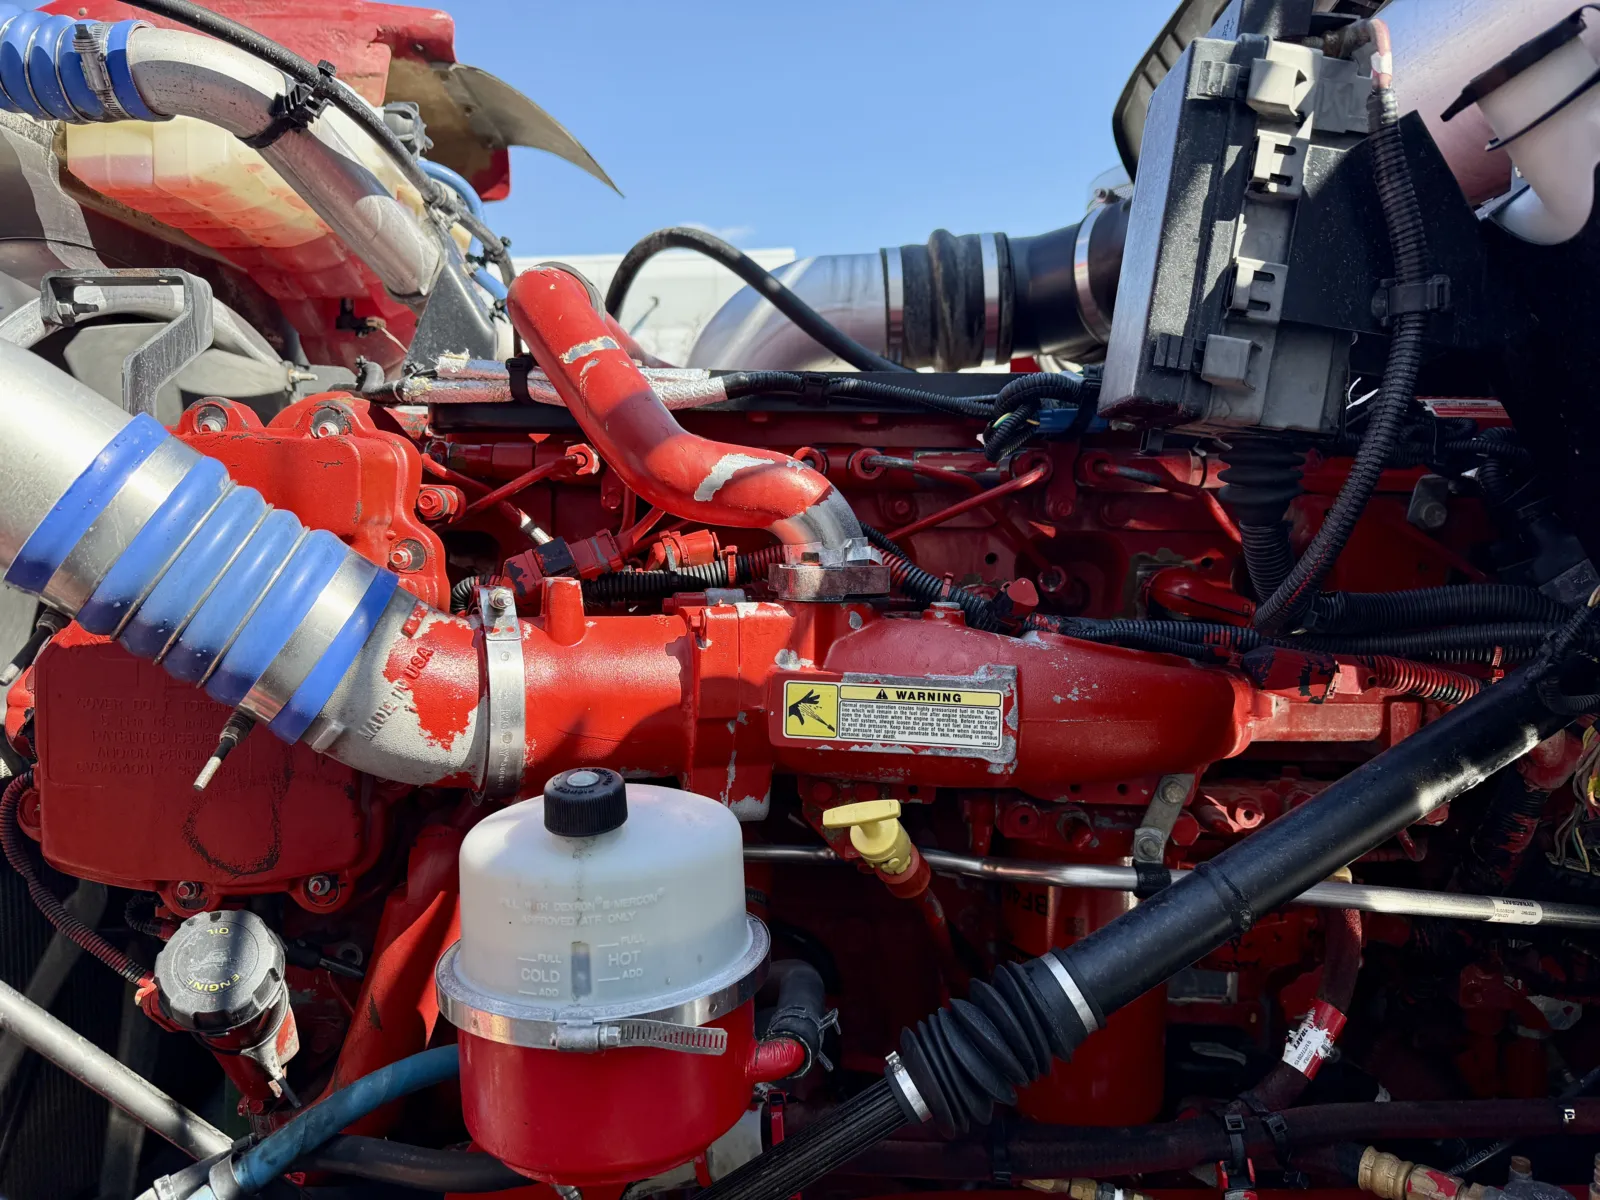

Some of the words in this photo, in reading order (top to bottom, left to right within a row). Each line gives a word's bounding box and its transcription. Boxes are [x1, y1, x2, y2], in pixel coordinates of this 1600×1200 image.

[405, 646, 434, 679] USA
[896, 690, 962, 702] WARNING
[522, 914, 575, 926] APPROVED
[580, 916, 602, 926] ATF
[608, 911, 637, 924] ONLY
[207, 927, 229, 935] OIL
[621, 934, 645, 944] FULL
[538, 954, 562, 964] FULL
[608, 950, 641, 966] HOT
[521, 968, 560, 983] COLD
[622, 968, 643, 979] ADD
[185, 973, 240, 992] ENGINE
[539, 988, 559, 997] ADD
